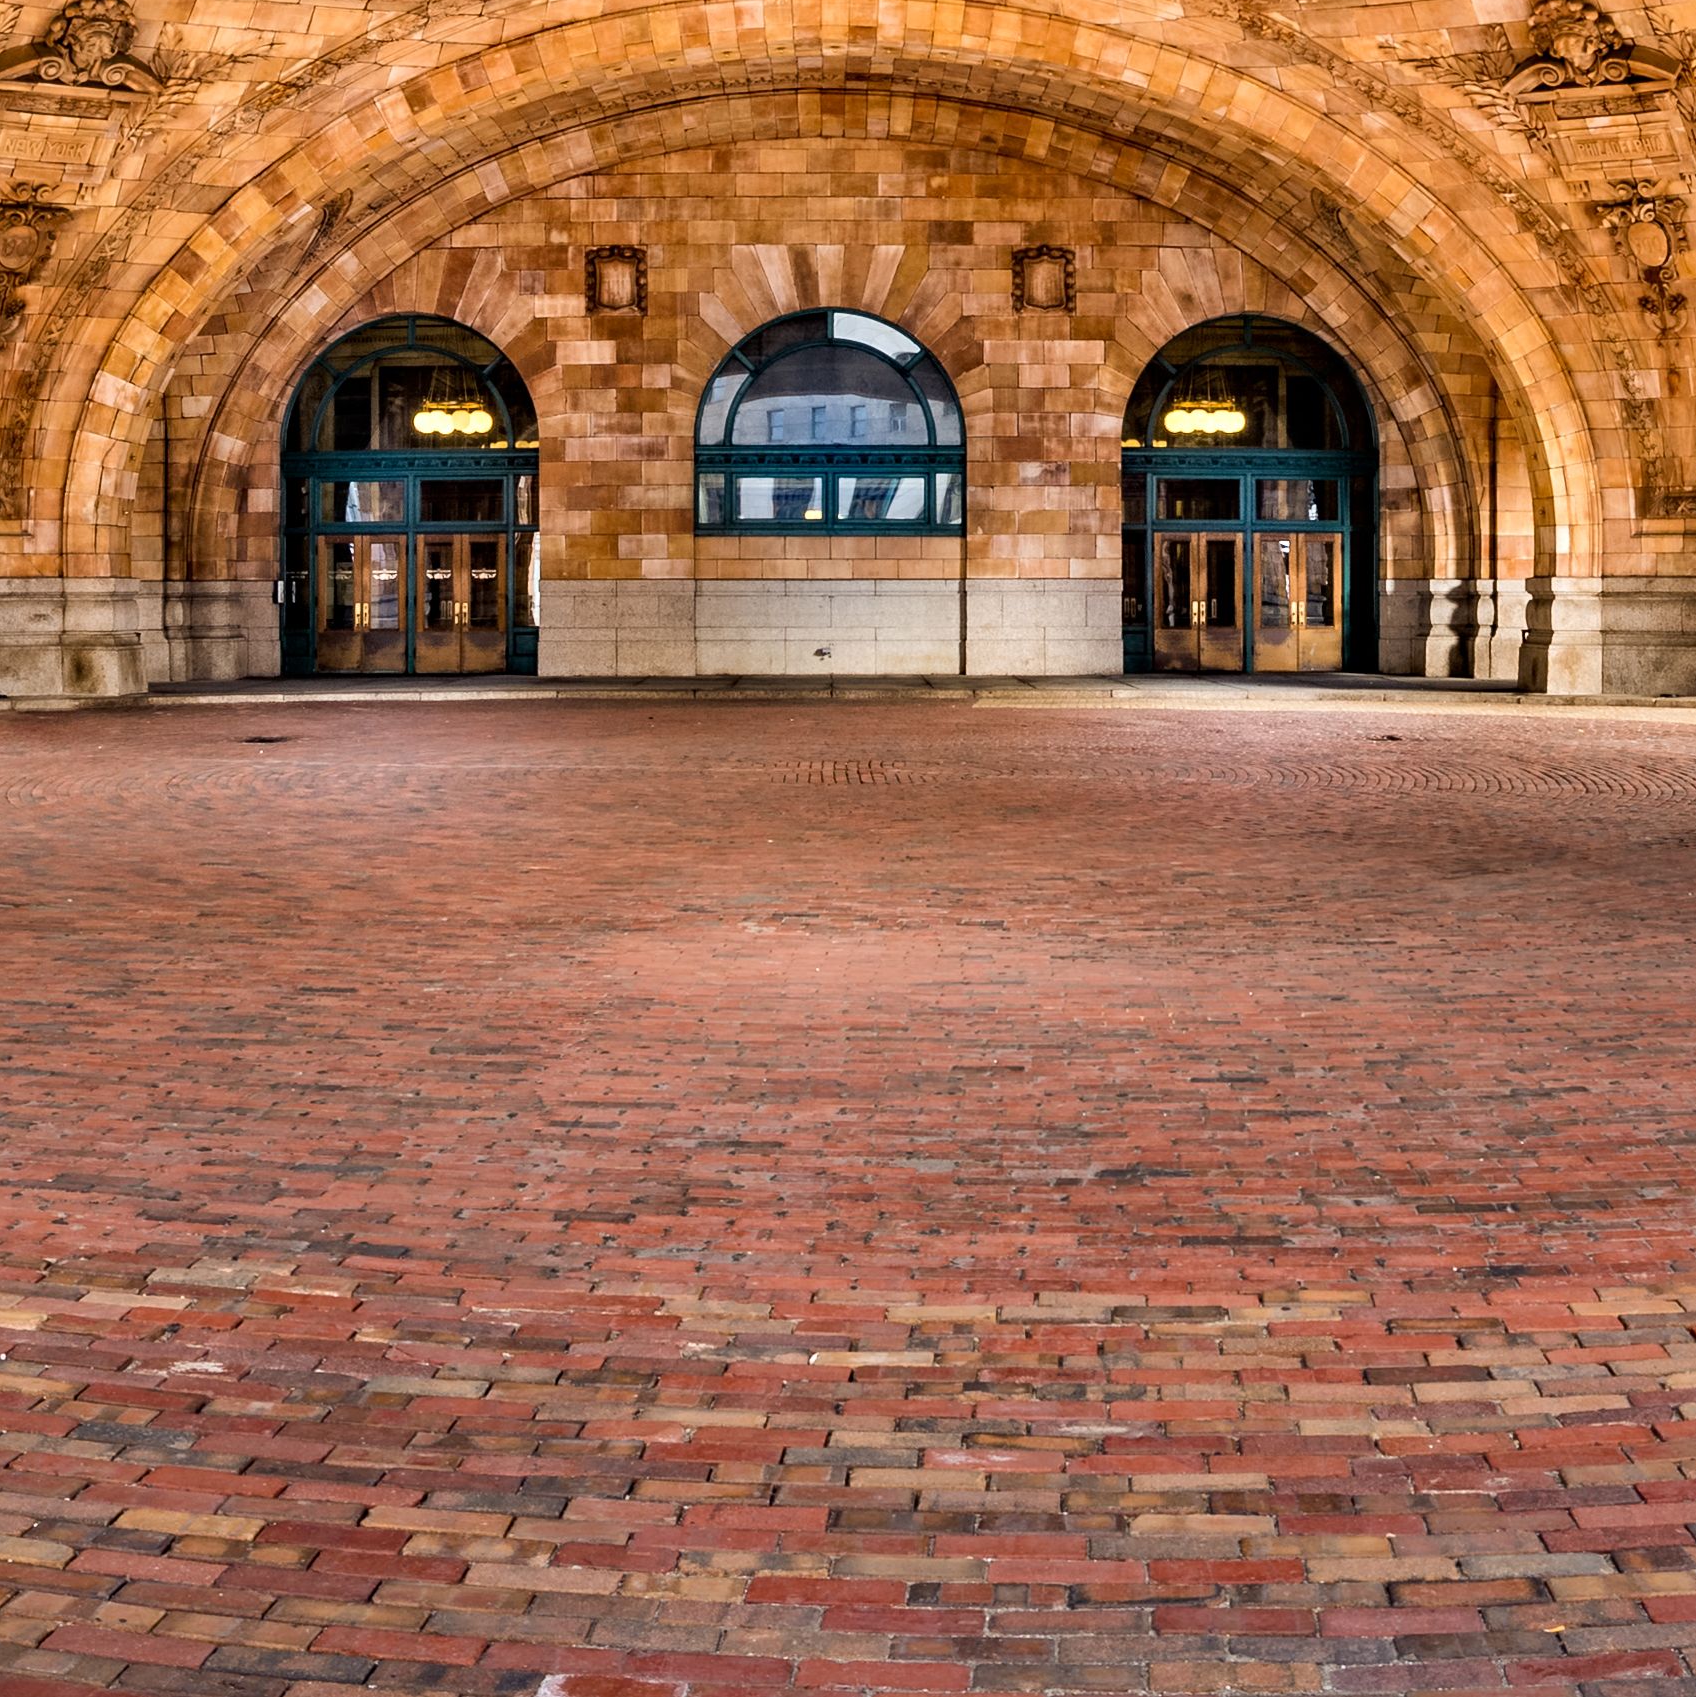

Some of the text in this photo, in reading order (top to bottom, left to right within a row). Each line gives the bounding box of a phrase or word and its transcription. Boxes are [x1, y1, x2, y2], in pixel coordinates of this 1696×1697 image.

[4, 138, 86, 158] NEW YORK
[1577, 133, 1666, 156] PHILADELPHIA
